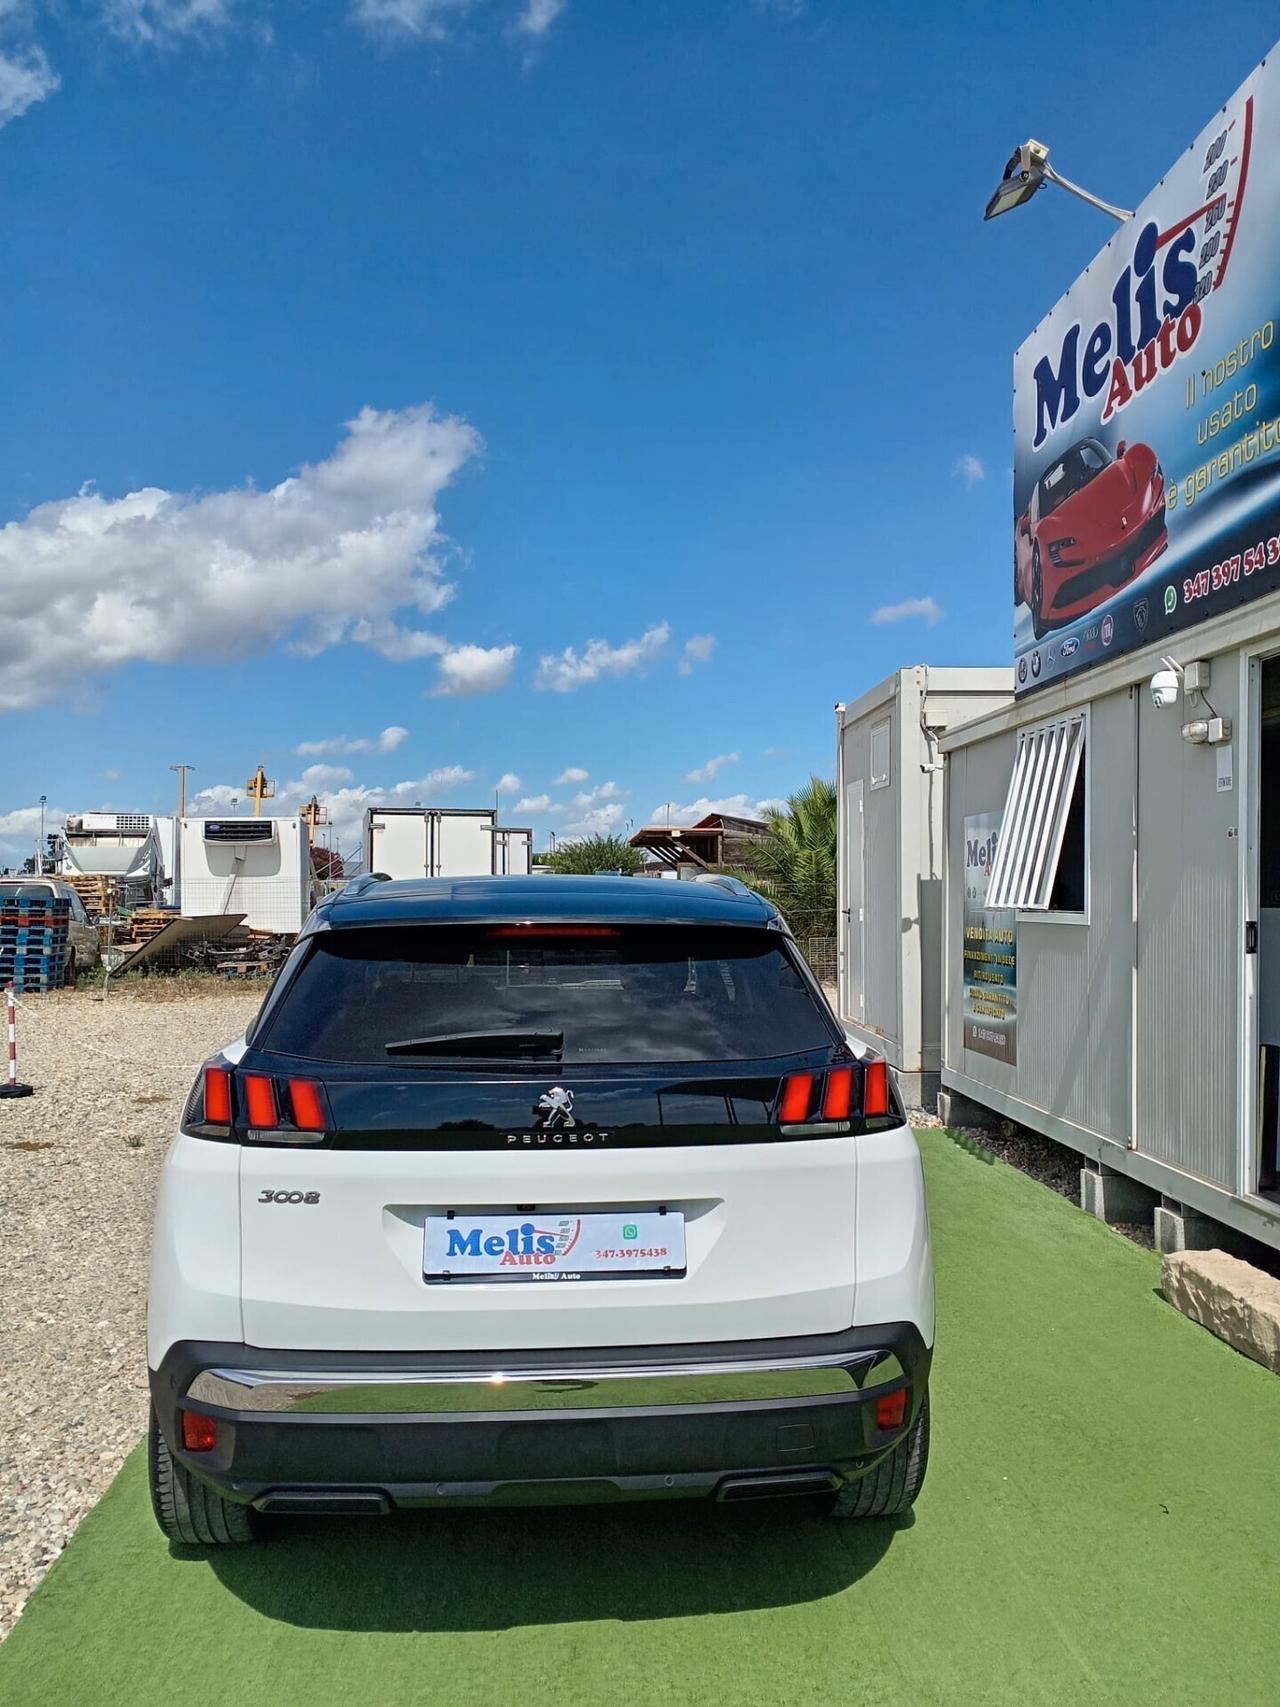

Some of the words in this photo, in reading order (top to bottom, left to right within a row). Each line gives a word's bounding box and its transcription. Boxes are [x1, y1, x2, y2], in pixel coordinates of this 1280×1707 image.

[1032, 222, 1198, 448] Melis
[1102, 303, 1201, 420] Auto
[1185, 373, 1196, 409] Il
[1202, 320, 1274, 397] nostro
[1197, 384, 1258, 446] usato
[1168, 478, 1178, 510] è
[1183, 569, 1210, 604] 347
[1212, 554, 1241, 590] 397
[1062, 640, 1077, 656] Ford
[966, 831, 998, 867] Meli
[507, 1133, 609, 1143] PEUGEOT
[258, 1189, 321, 1204] 3008
[446, 1223, 555, 1257] Melis
[595, 1247, 668, 1259] 347.3975438
[499, 1251, 556, 1266] Auto
[561, 1272, 581, 1280] Auto
